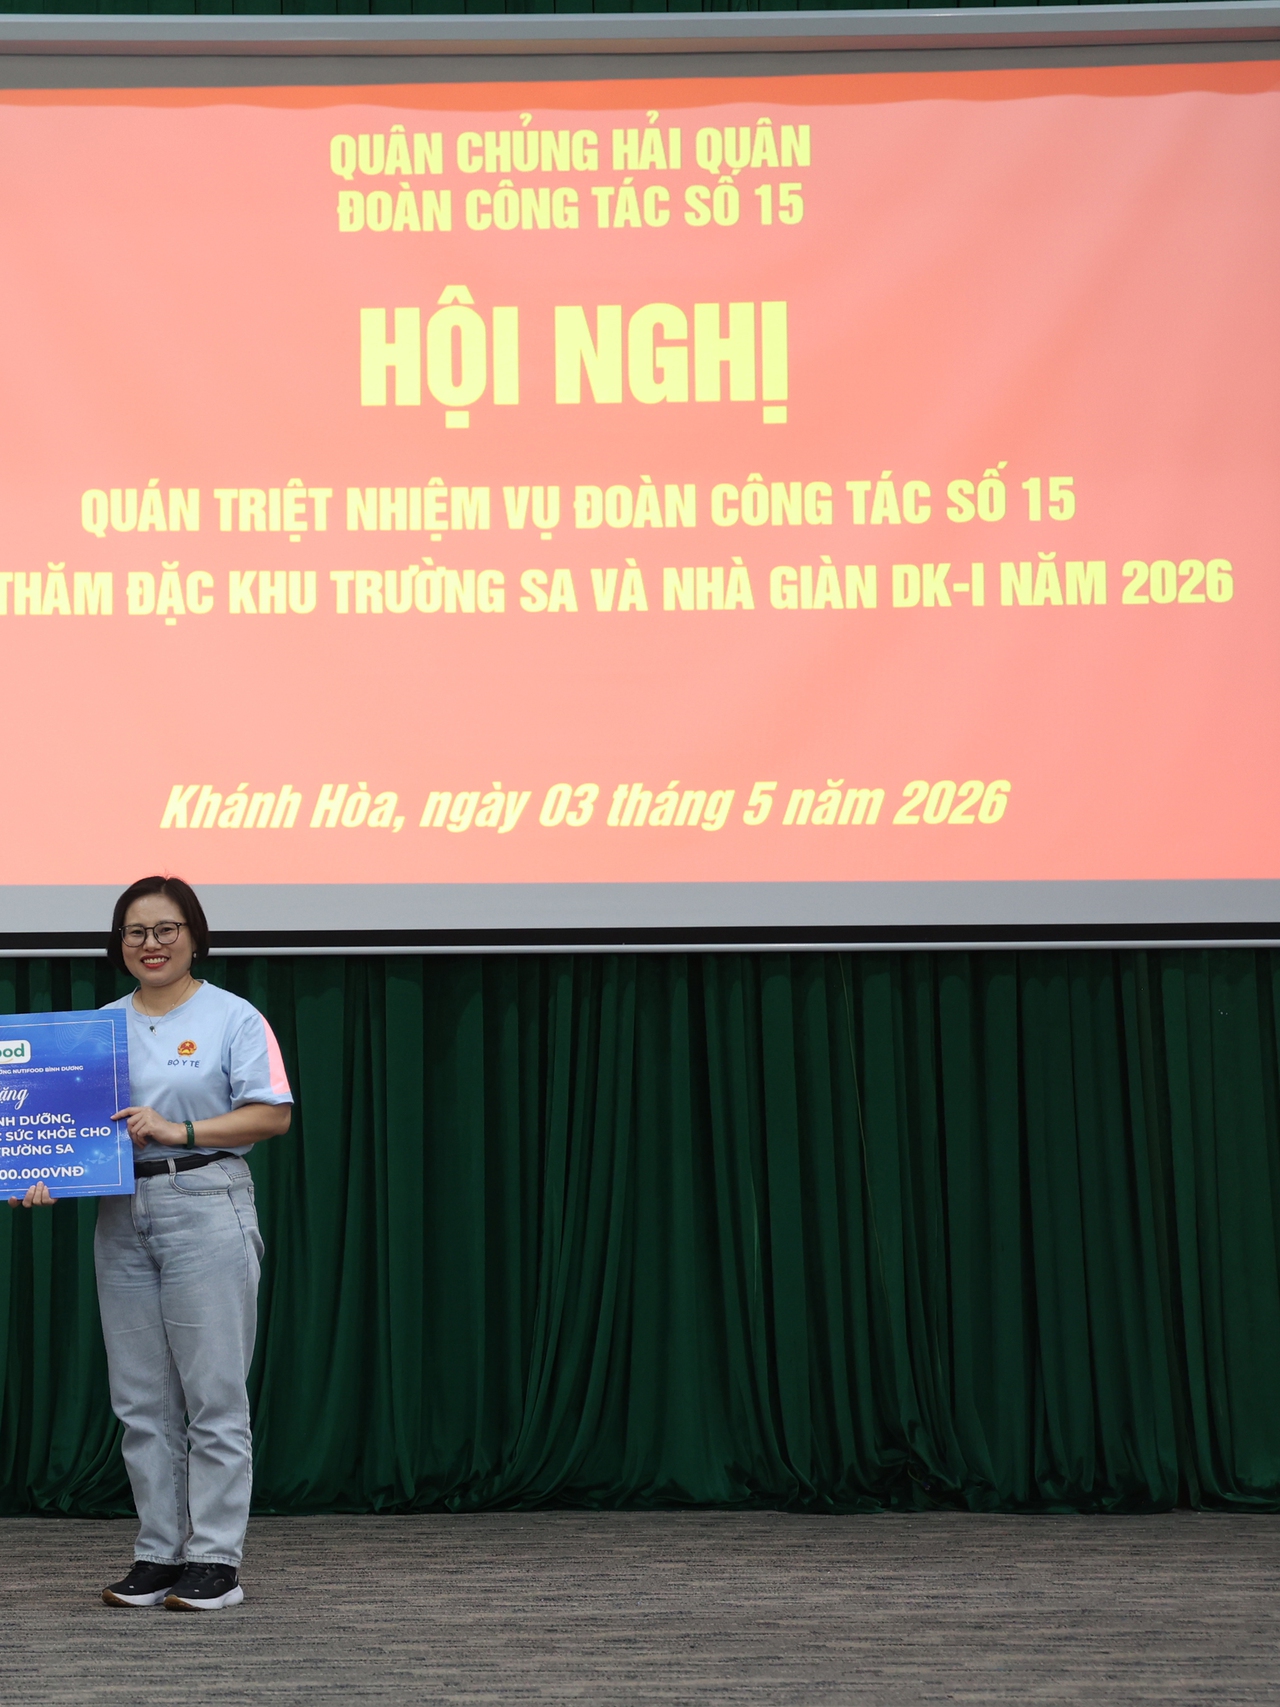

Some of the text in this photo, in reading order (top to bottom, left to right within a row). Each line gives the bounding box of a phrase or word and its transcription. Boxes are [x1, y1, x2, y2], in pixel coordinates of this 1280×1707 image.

[330, 110, 811, 180] QUÂN CHỦNG HẢI QUÂN
[336, 169, 804, 232] ĐOÀN CÔNG TÁC SỐ 15
[360, 285, 788, 428] HỘI NGHỊ
[81, 461, 1076, 542] QUÁN TRIỆT NHIỆM VỤ ĐOÀN CÔNG TÁC SỐ 15
[126, 561, 214, 626] ĐẶC
[229, 571, 317, 614] KHU
[330, 557, 505, 614] TRƯỜNG
[519, 569, 578, 612] SA
[591, 558, 648, 612] VÀ
[663, 556, 755, 611] NHÀ
[770, 555, 877, 609] GIÀN
[892, 563, 984, 607] DK-I
[1000, 552, 1107, 606] NĂM
[1121, 558, 1234, 604] 2026
[160, 779, 1011, 834] Khánh Hòa, ngày 03 tháng 5 năm 2026
[5, 1128, 33, 1141] SỨC
[37, 1126, 76, 1139] KHỎE
[80, 1126, 111, 1138] CHO
[20, 1112, 75, 1126] DƯỠNG,
[55, 1144, 74, 1154] SA
